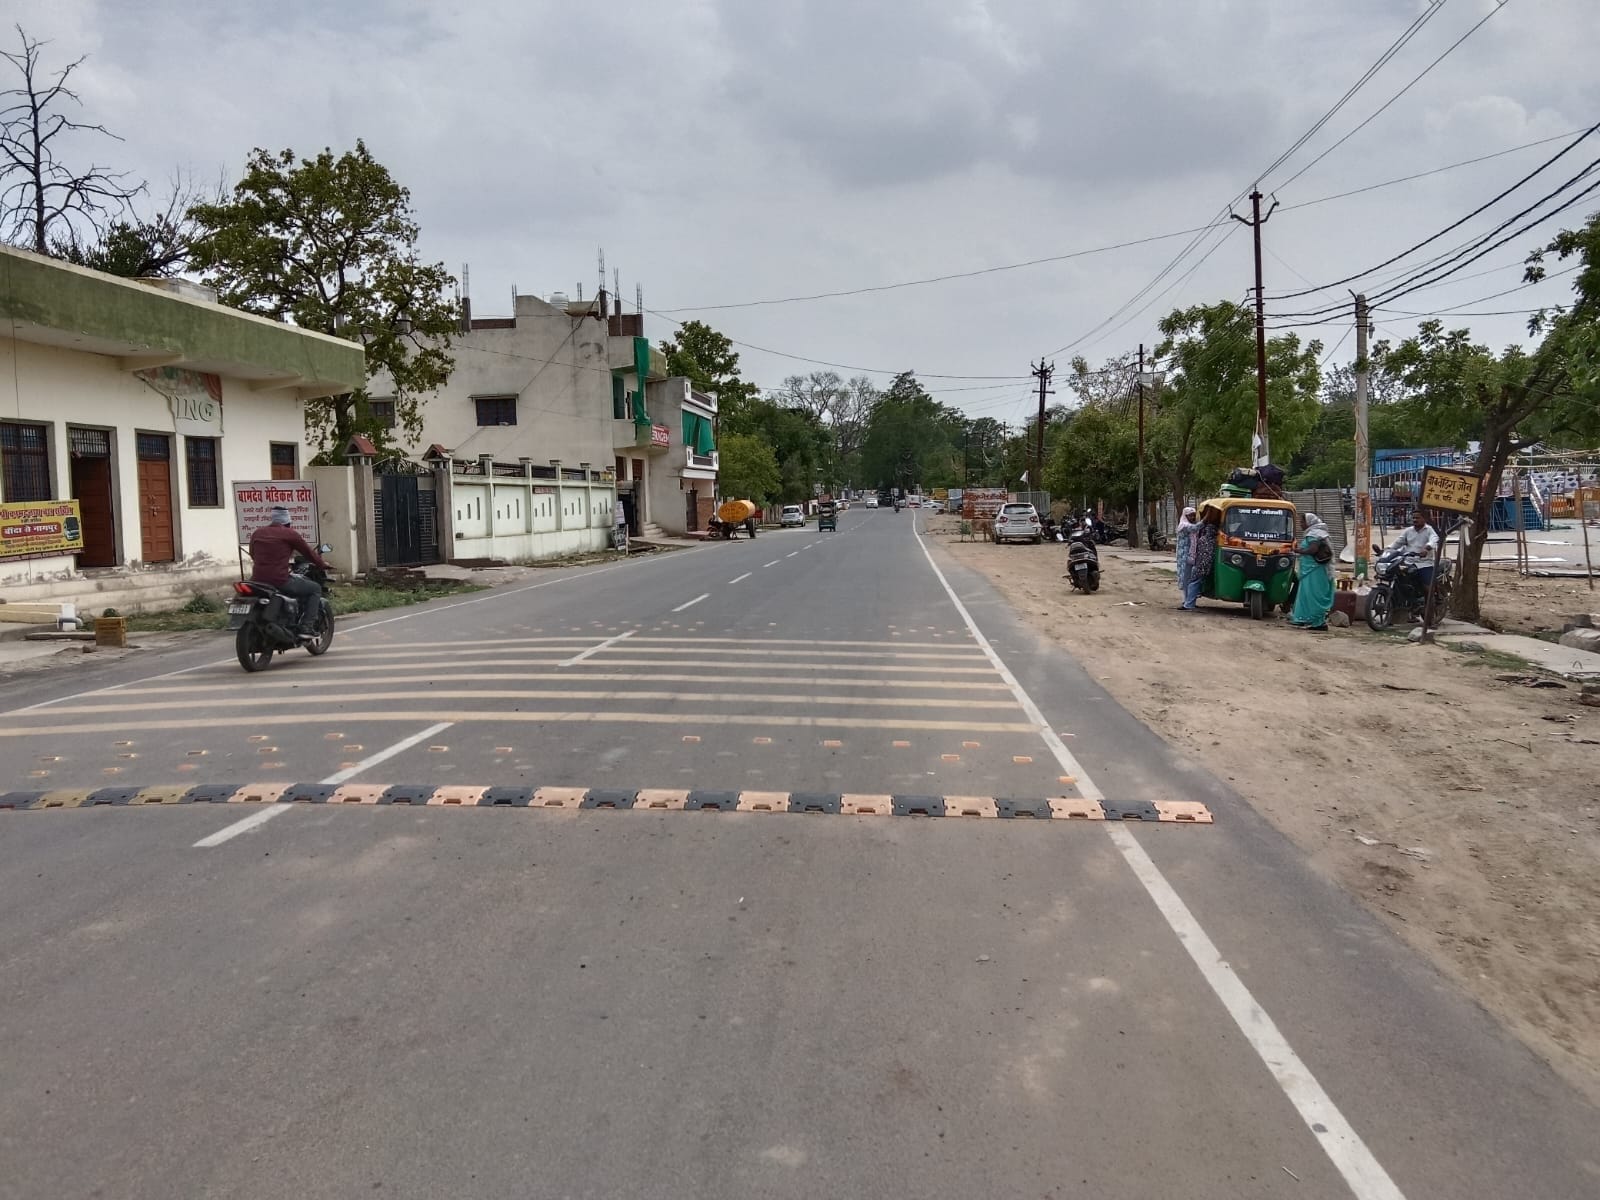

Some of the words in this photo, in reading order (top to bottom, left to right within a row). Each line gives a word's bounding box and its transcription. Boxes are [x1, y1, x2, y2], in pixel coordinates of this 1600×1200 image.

[265, 486, 294, 502] मेडिकल
[296, 485, 312, 502] स्टोर
[33, 524, 58, 533] नागपुर
